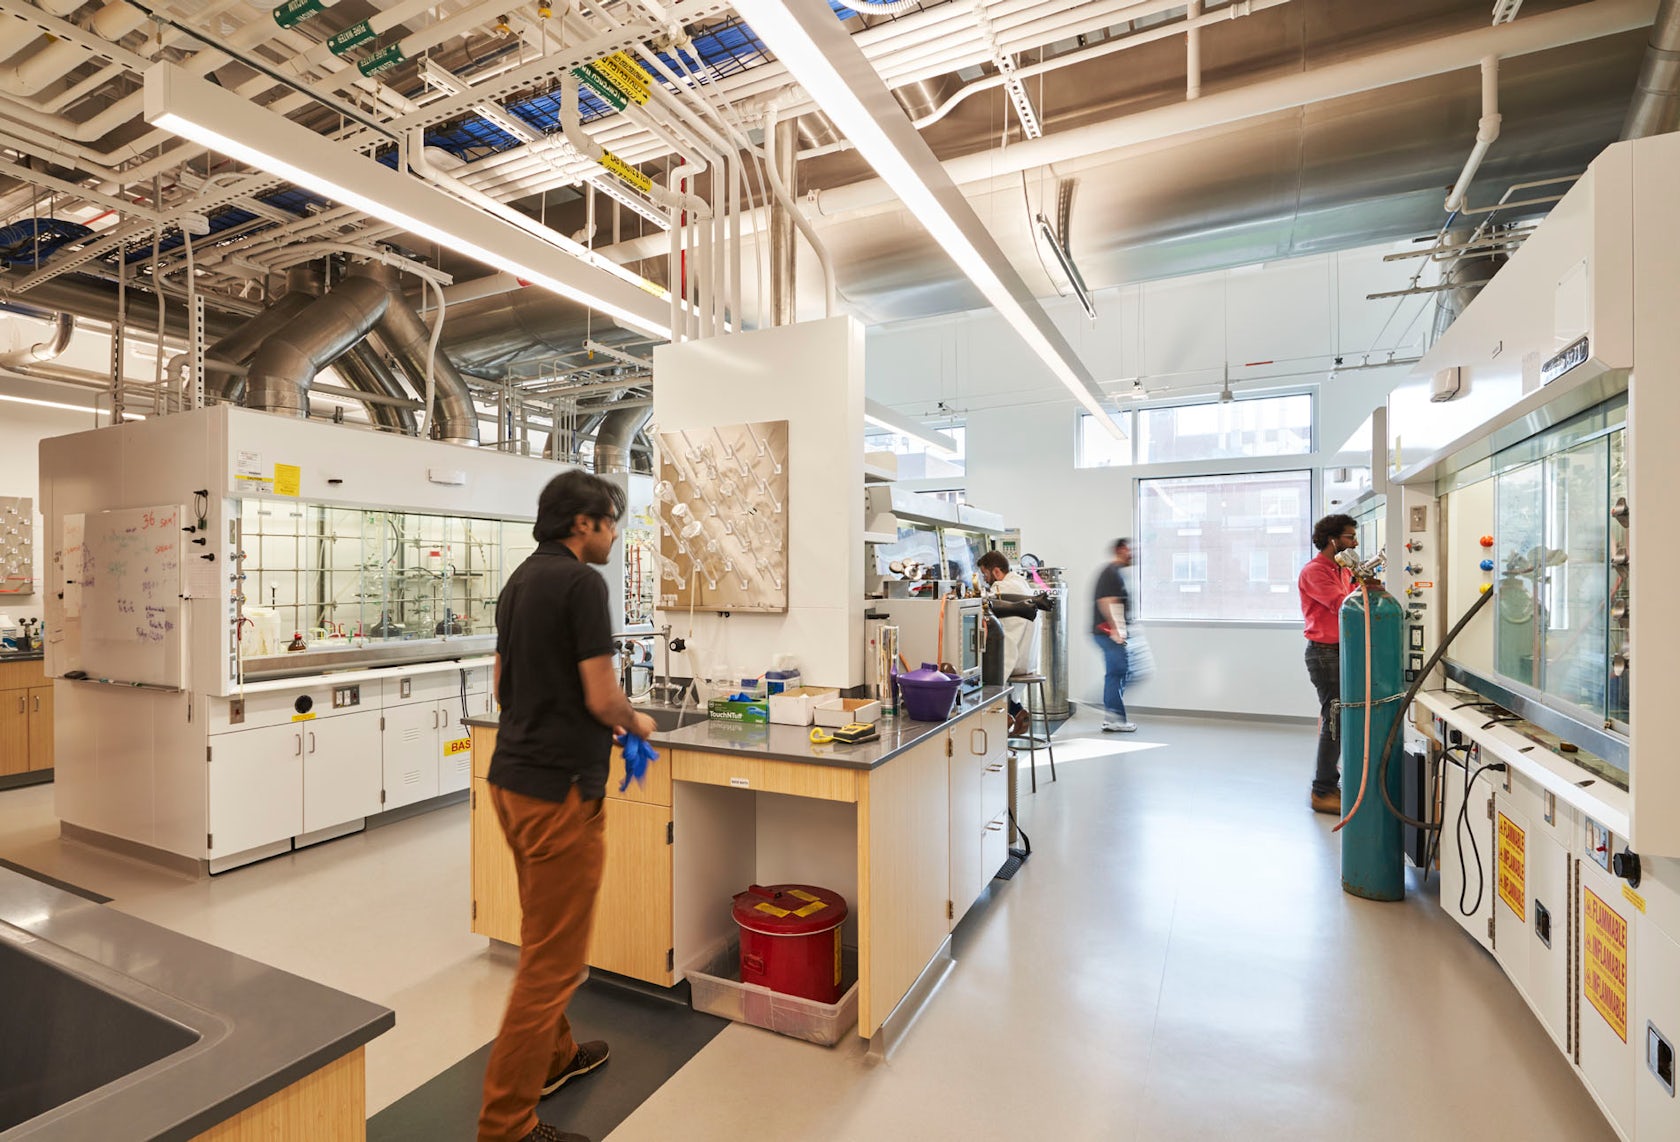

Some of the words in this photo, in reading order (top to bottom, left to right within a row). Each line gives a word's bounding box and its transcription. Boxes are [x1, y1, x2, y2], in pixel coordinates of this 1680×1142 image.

[709, 710, 743, 719] TouchNTuff
[451, 739, 471, 752] BAS
[1592, 899, 1626, 949] FLAMMABLE
